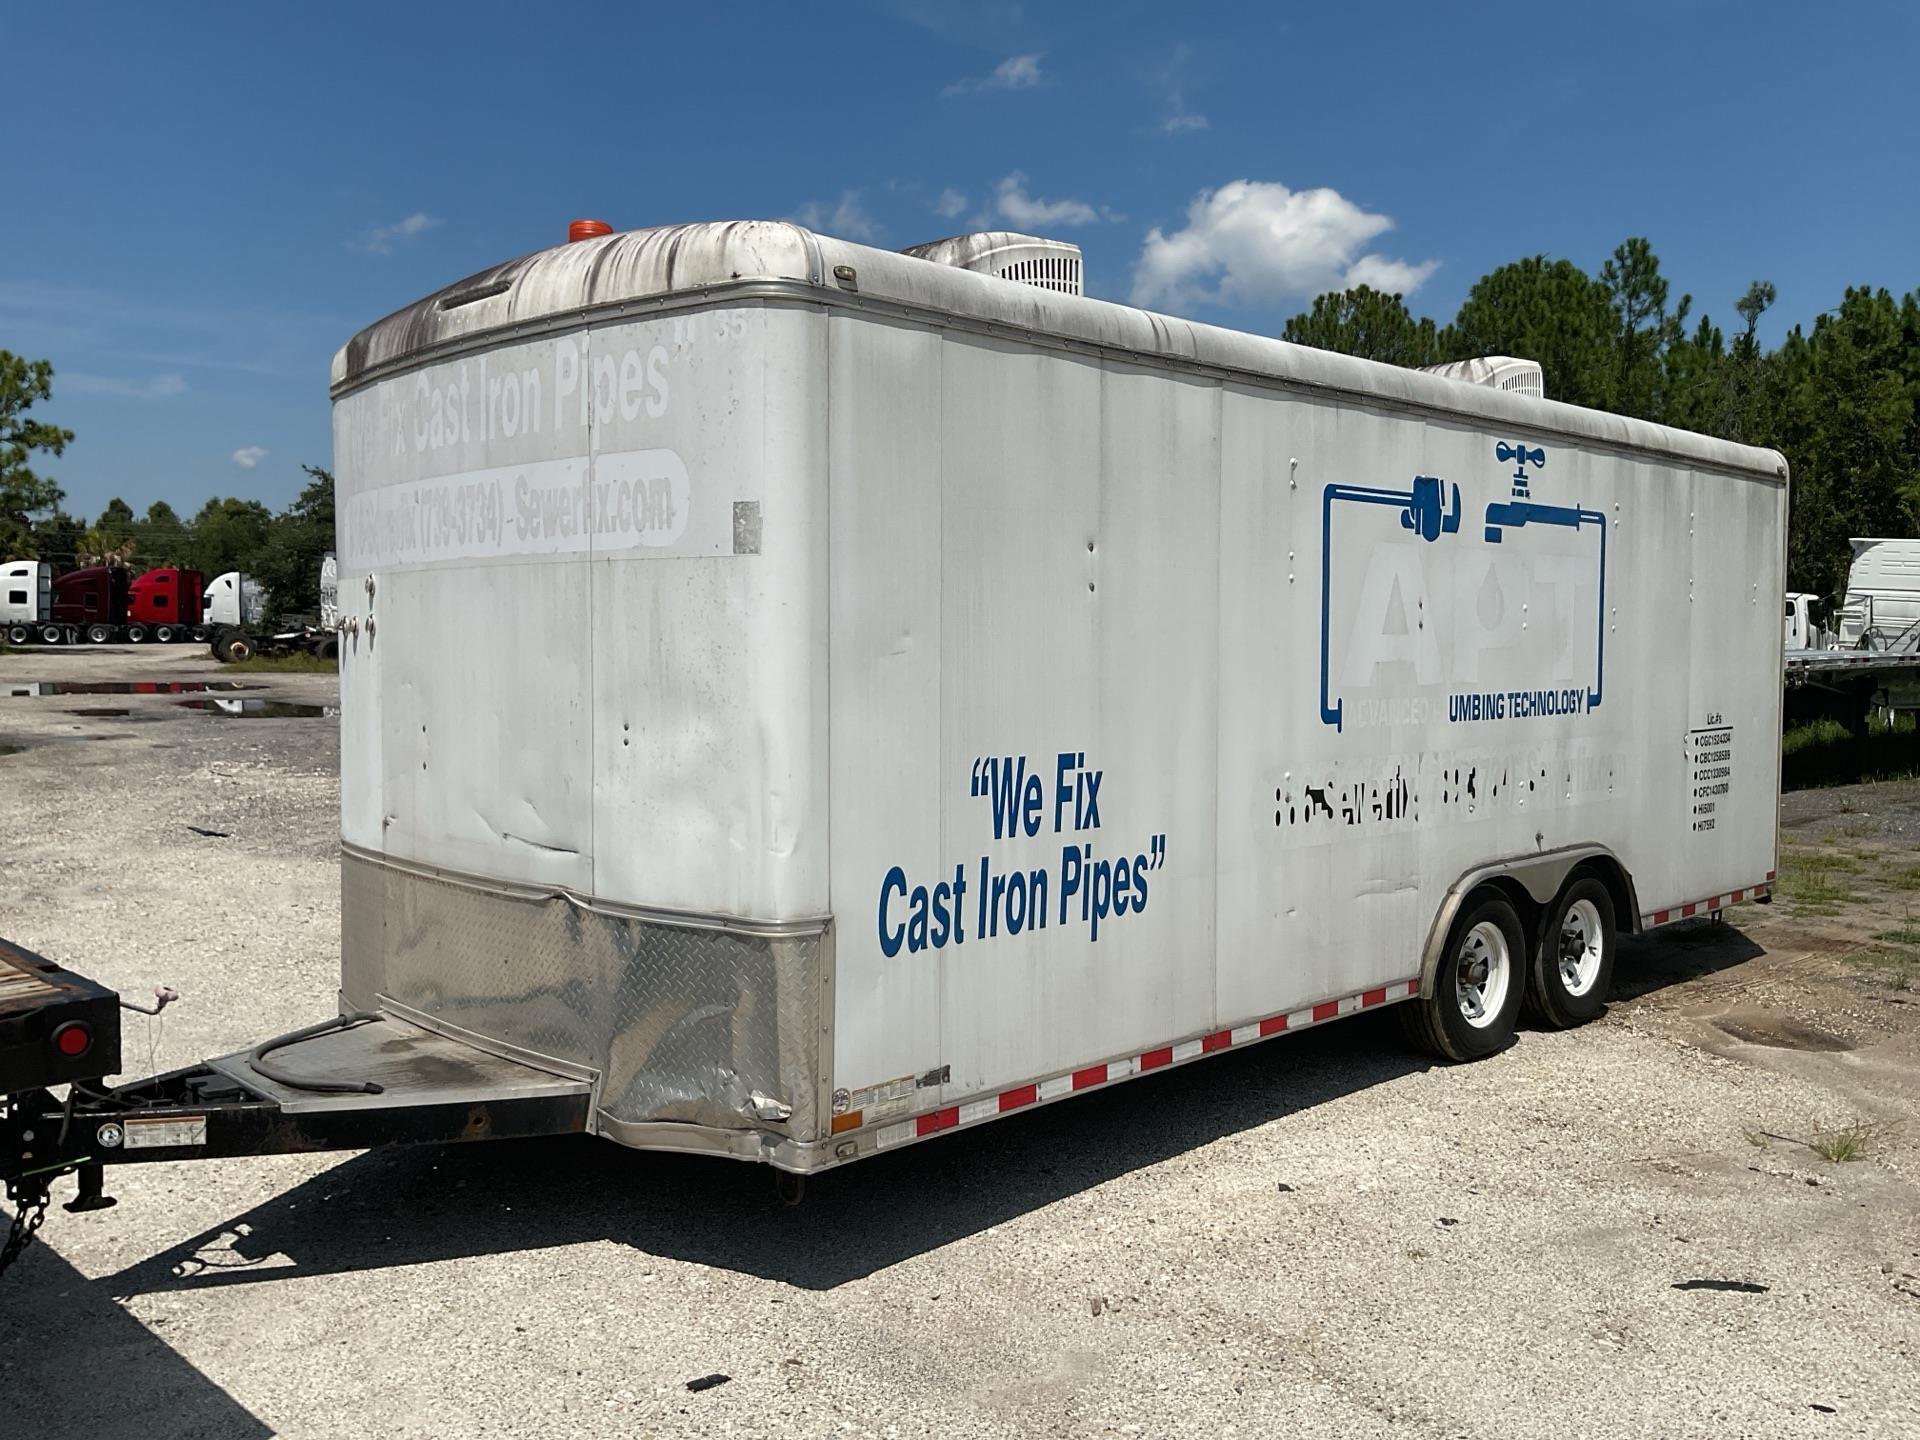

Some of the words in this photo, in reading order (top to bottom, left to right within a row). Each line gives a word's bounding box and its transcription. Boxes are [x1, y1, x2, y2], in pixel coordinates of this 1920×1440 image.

[479, 357, 541, 443] Iron
[1507, 688, 1585, 718] TECHNOLOGY
[1054, 752, 1103, 833] Fix
[878, 863, 967, 958] Cast
[978, 856, 1048, 940] Iron
